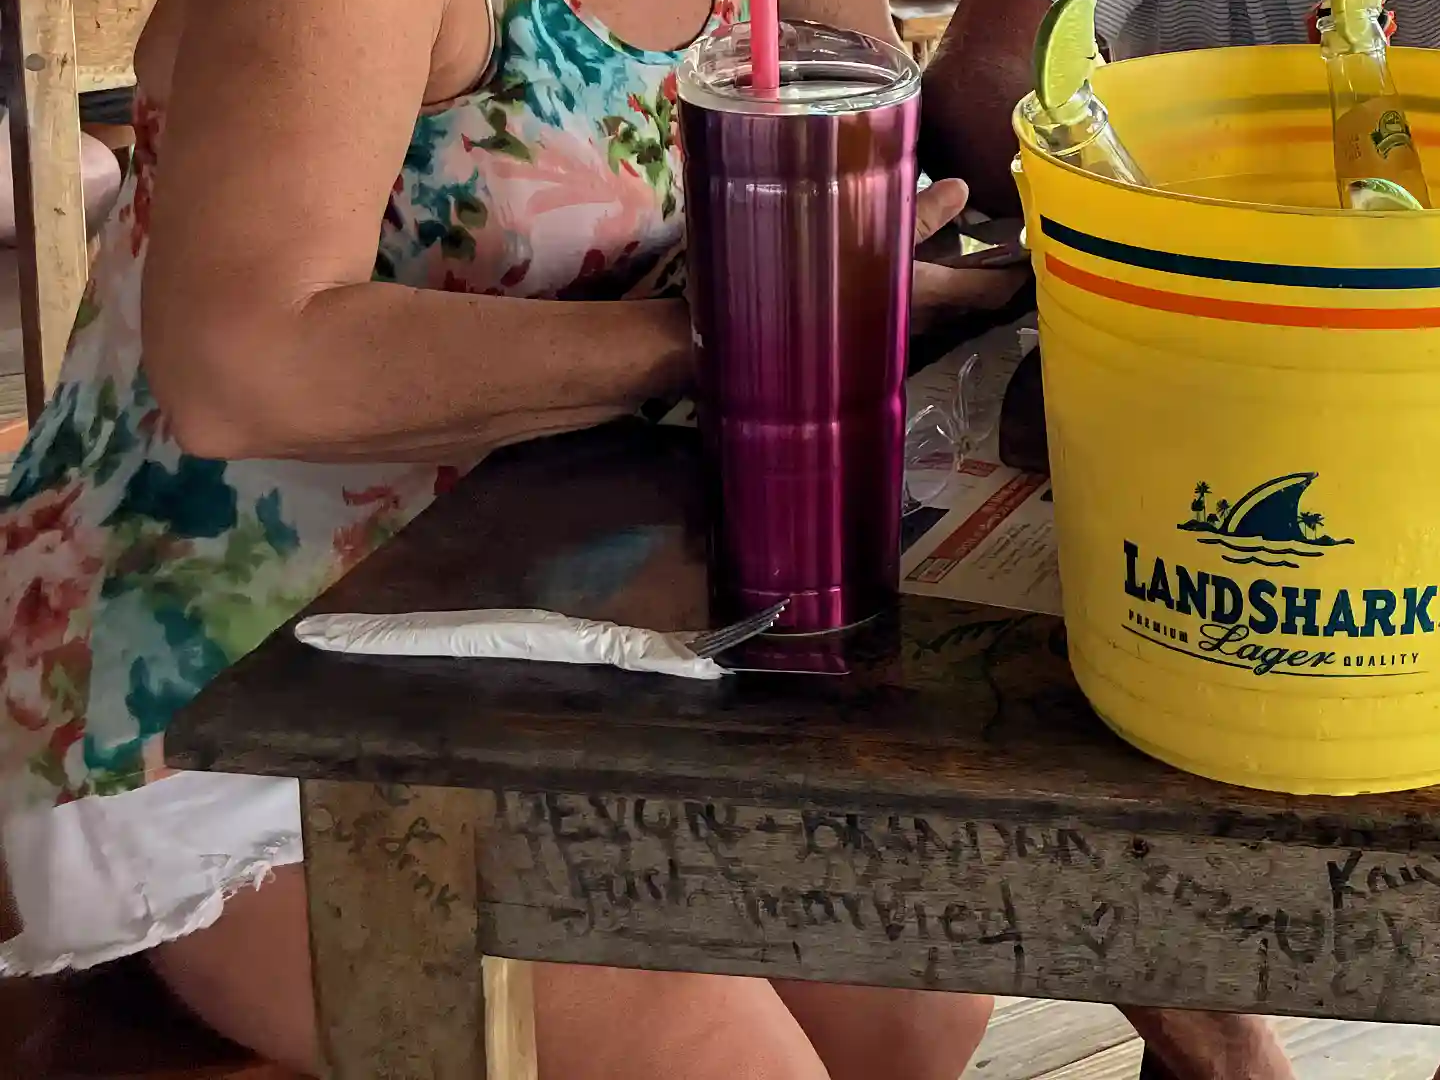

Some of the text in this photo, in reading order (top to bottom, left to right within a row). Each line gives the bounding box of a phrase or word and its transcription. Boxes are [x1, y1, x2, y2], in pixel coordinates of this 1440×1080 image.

[1122, 537, 1439, 639] LANDSHARK
[1128, 608, 1420, 677] PREMIUM Lager QUALITY
